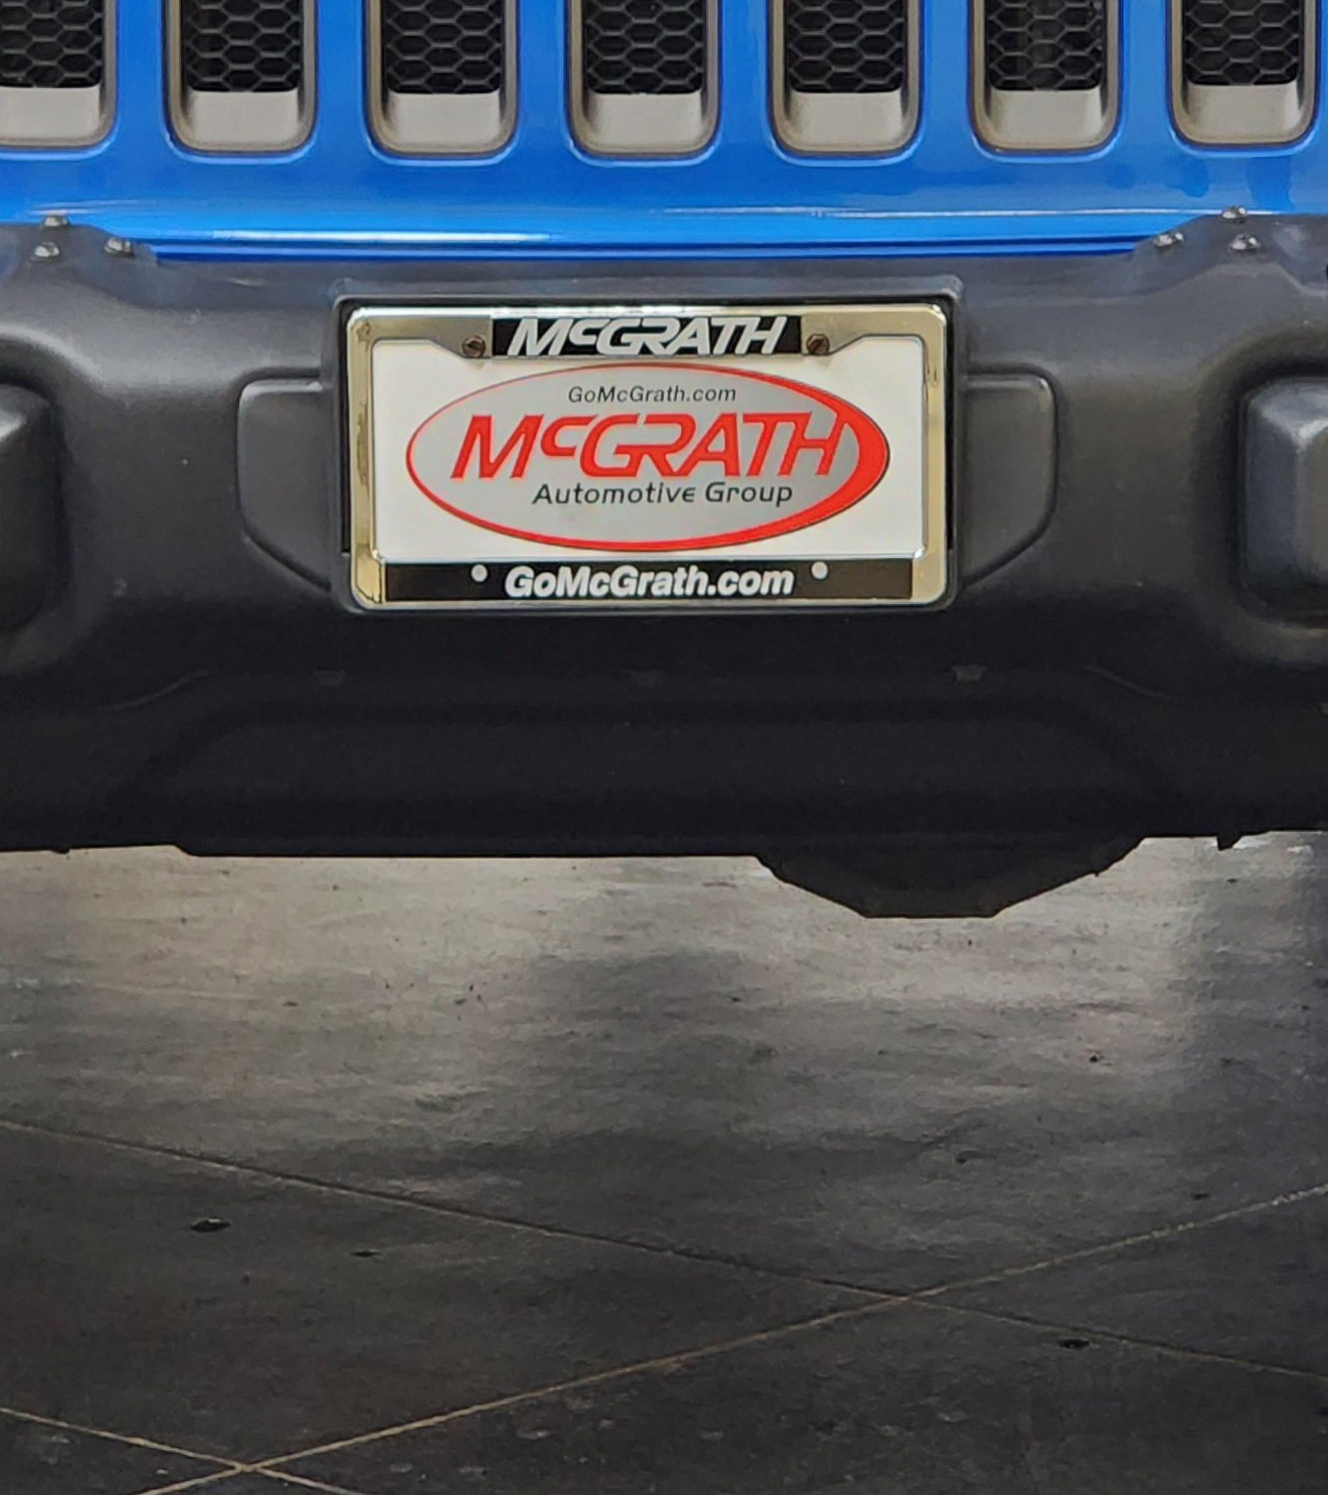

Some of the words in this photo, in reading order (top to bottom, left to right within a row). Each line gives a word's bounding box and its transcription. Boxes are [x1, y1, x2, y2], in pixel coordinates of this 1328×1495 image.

[568, 385, 737, 404] GoMcGrath.com
[532, 482, 696, 504] Automotive
[705, 482, 793, 508] Group
[504, 563, 795, 598] GoMcGrath.com
